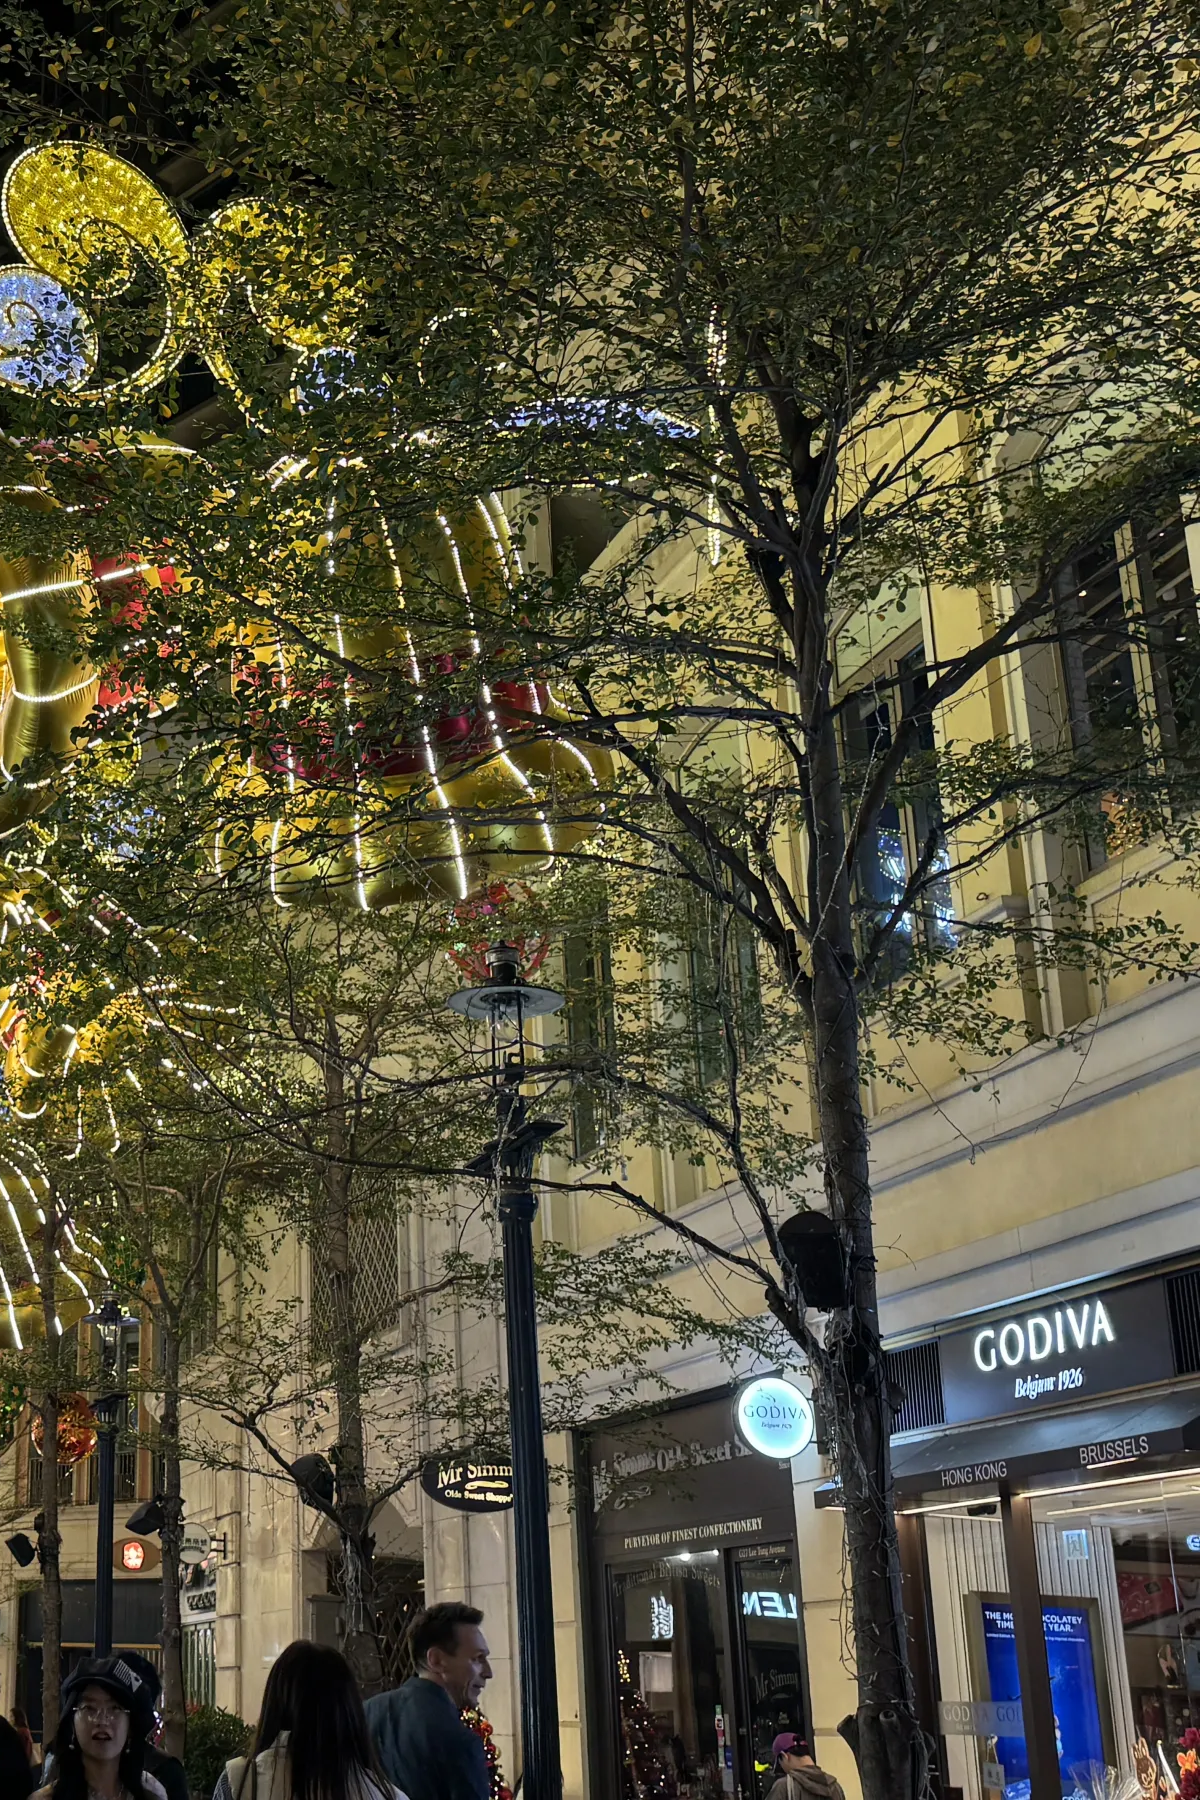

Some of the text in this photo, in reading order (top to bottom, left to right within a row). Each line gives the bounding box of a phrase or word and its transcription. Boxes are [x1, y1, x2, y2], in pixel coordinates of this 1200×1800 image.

[974, 1300, 1115, 1372] GODIVA
[1015, 1367, 1083, 1399] Belgium 1926
[744, 1405, 807, 1419] GODIVA
[1080, 1436, 1149, 1464] BRUSSELS
[437, 1461, 463, 1489] Mr
[941, 1461, 1007, 1487] HONG KONG
[624, 1517, 763, 1549] PURVEYOR OF FINEST CONFECTIONERY
[749, 1547, 757, 1557] Lee
[985, 1611, 1001, 1620] THE
[1048, 1624, 1074, 1633] YEAR.
